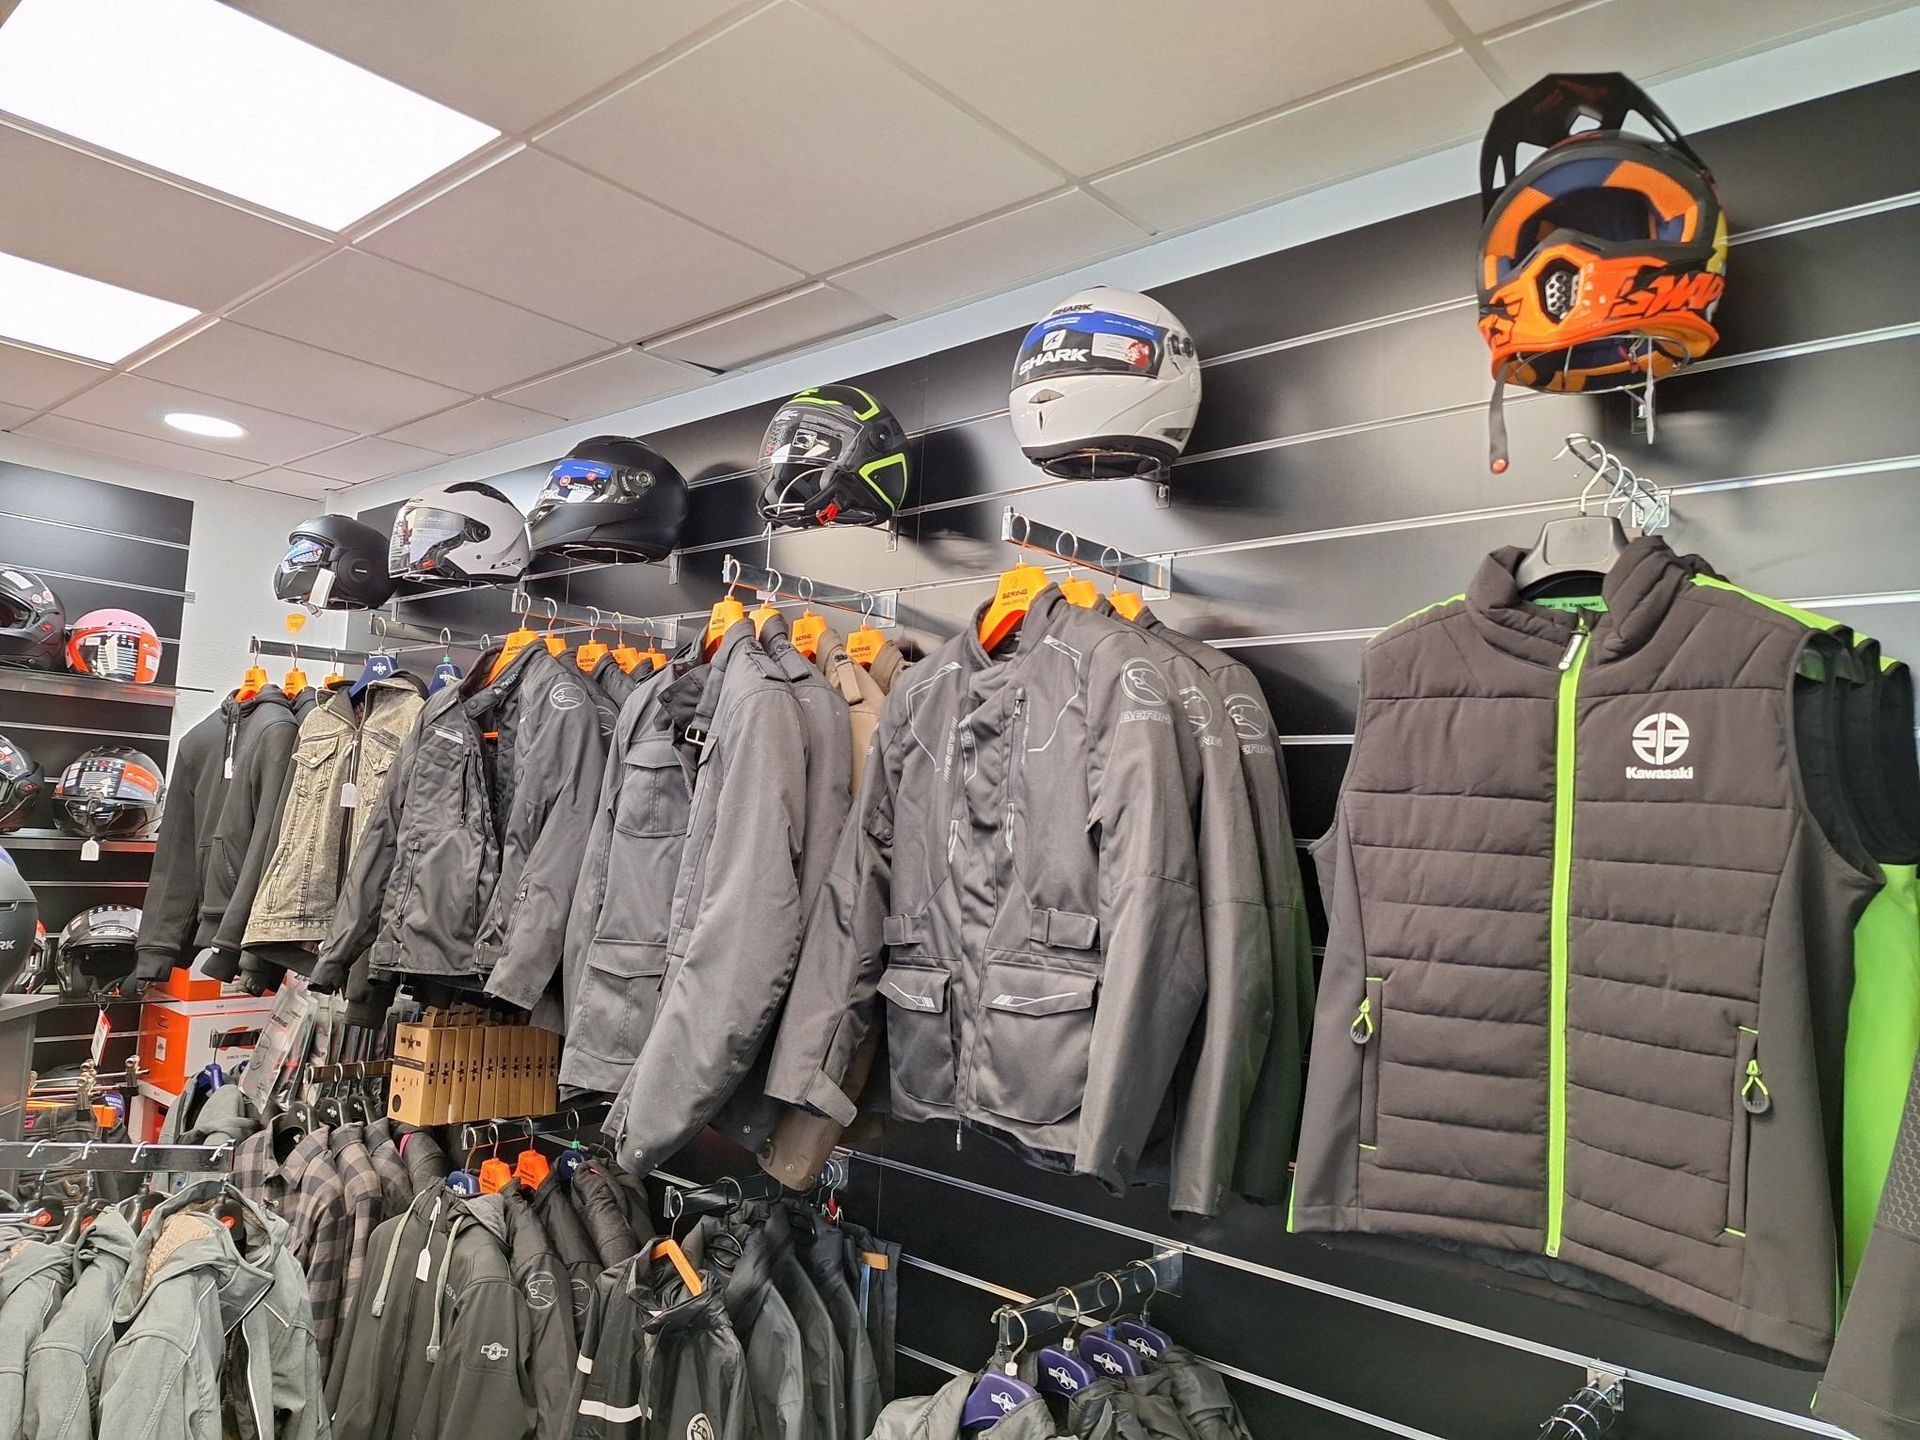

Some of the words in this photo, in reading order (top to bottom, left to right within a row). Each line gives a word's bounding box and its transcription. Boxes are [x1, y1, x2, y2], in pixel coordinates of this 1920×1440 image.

[1051, 303, 1093, 316] SHARK
[1018, 349, 1090, 376] SHARK
[1625, 766, 1694, 780] Kawasaki
